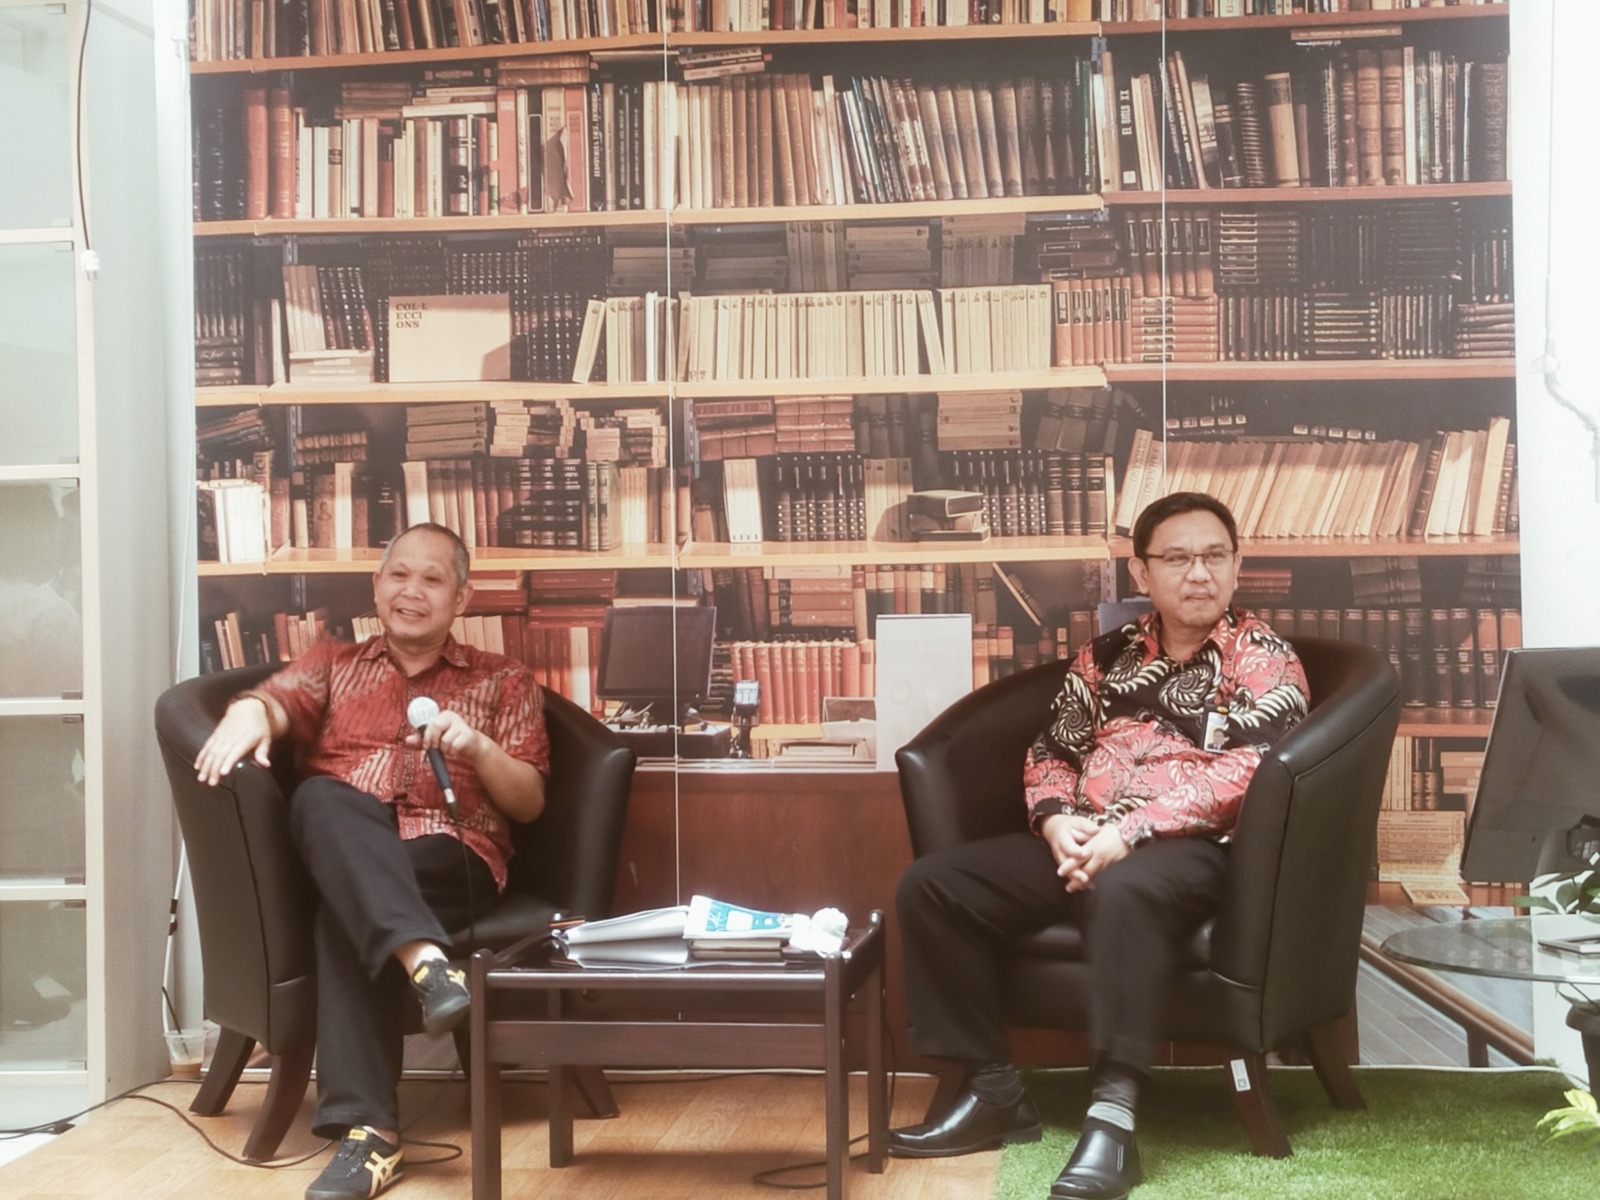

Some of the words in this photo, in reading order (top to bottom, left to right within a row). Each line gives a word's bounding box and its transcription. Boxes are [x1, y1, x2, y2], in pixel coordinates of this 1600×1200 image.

[1120, 90, 1130, 101] XX
[1120, 105, 1131, 124] SIGLO
[1121, 126, 1132, 135] EL
[396, 311, 422, 320] ECCI
[395, 320, 420, 329] ONS
[1143, 448, 1160, 494] PARNASO
